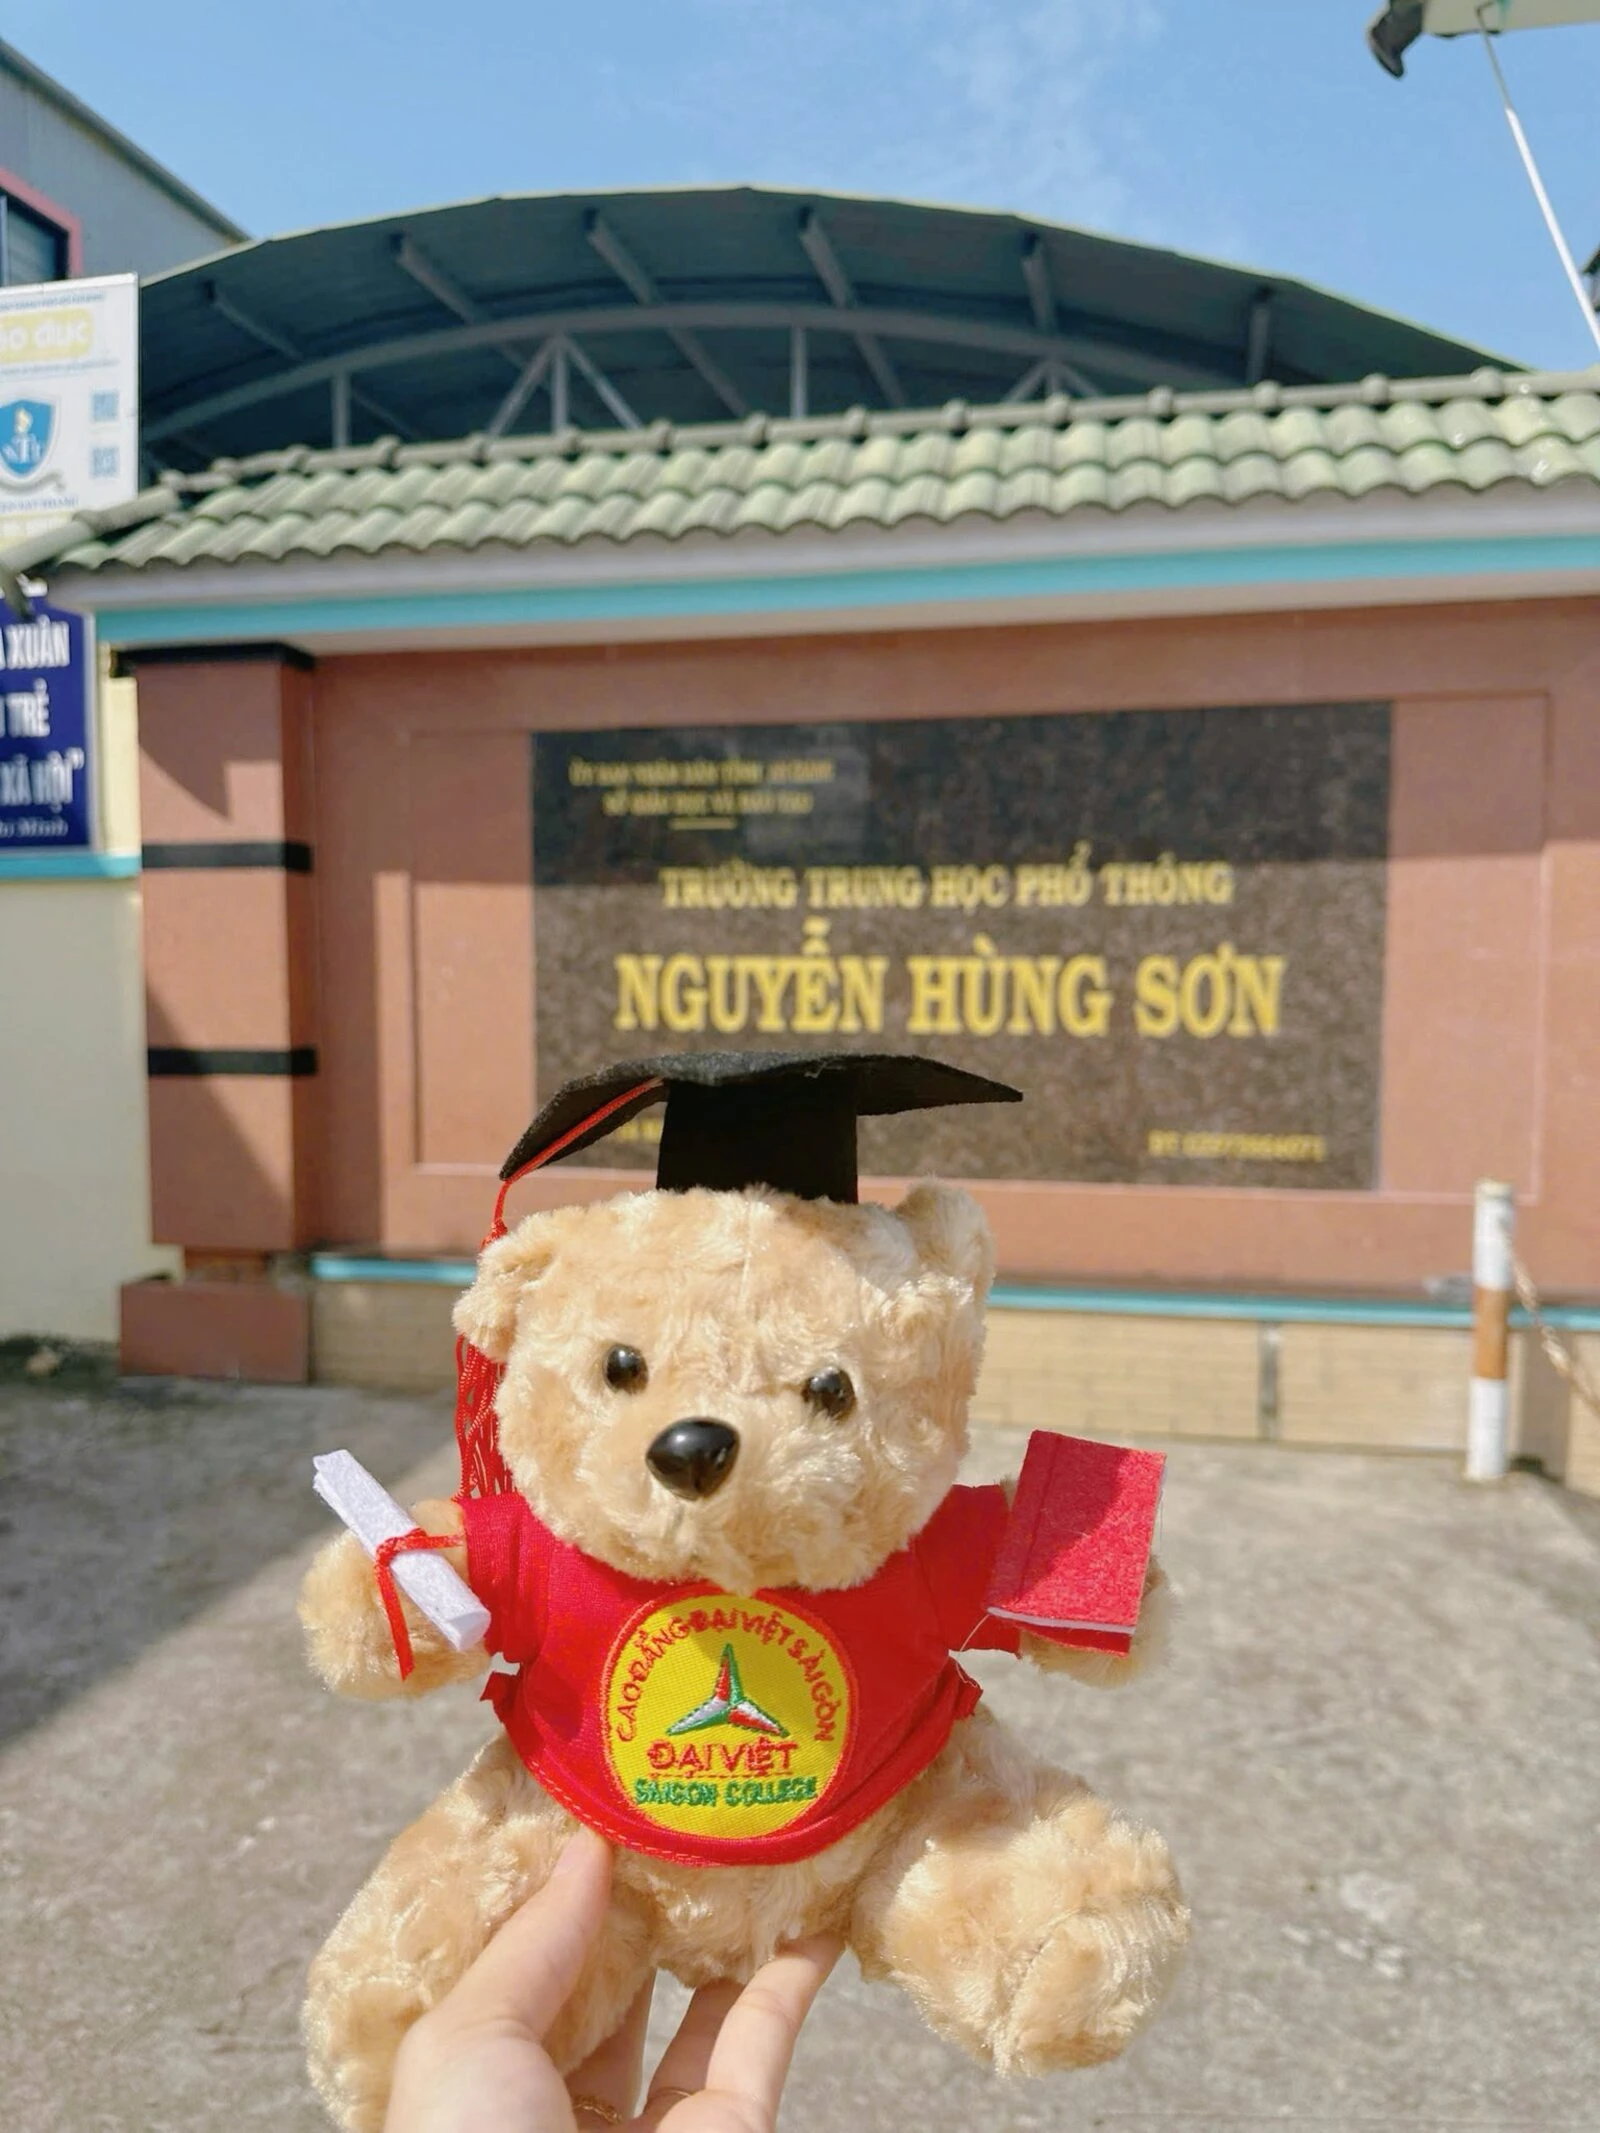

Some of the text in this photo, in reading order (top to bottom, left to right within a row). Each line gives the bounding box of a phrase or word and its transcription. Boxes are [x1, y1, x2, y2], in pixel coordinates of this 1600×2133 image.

[6, 615, 71, 669] XUÂN
[659, 838, 1235, 914] TRƯỜNG TRUNG HỌC PHỔ THÔNG
[613, 916, 1287, 1039] NGUYỄN HÙNG SƠN
[616, 1681, 644, 1743] CAO
[647, 1735, 798, 1778] ĐẠI VIỆT
[723, 1776, 817, 1808] COLLEGE
